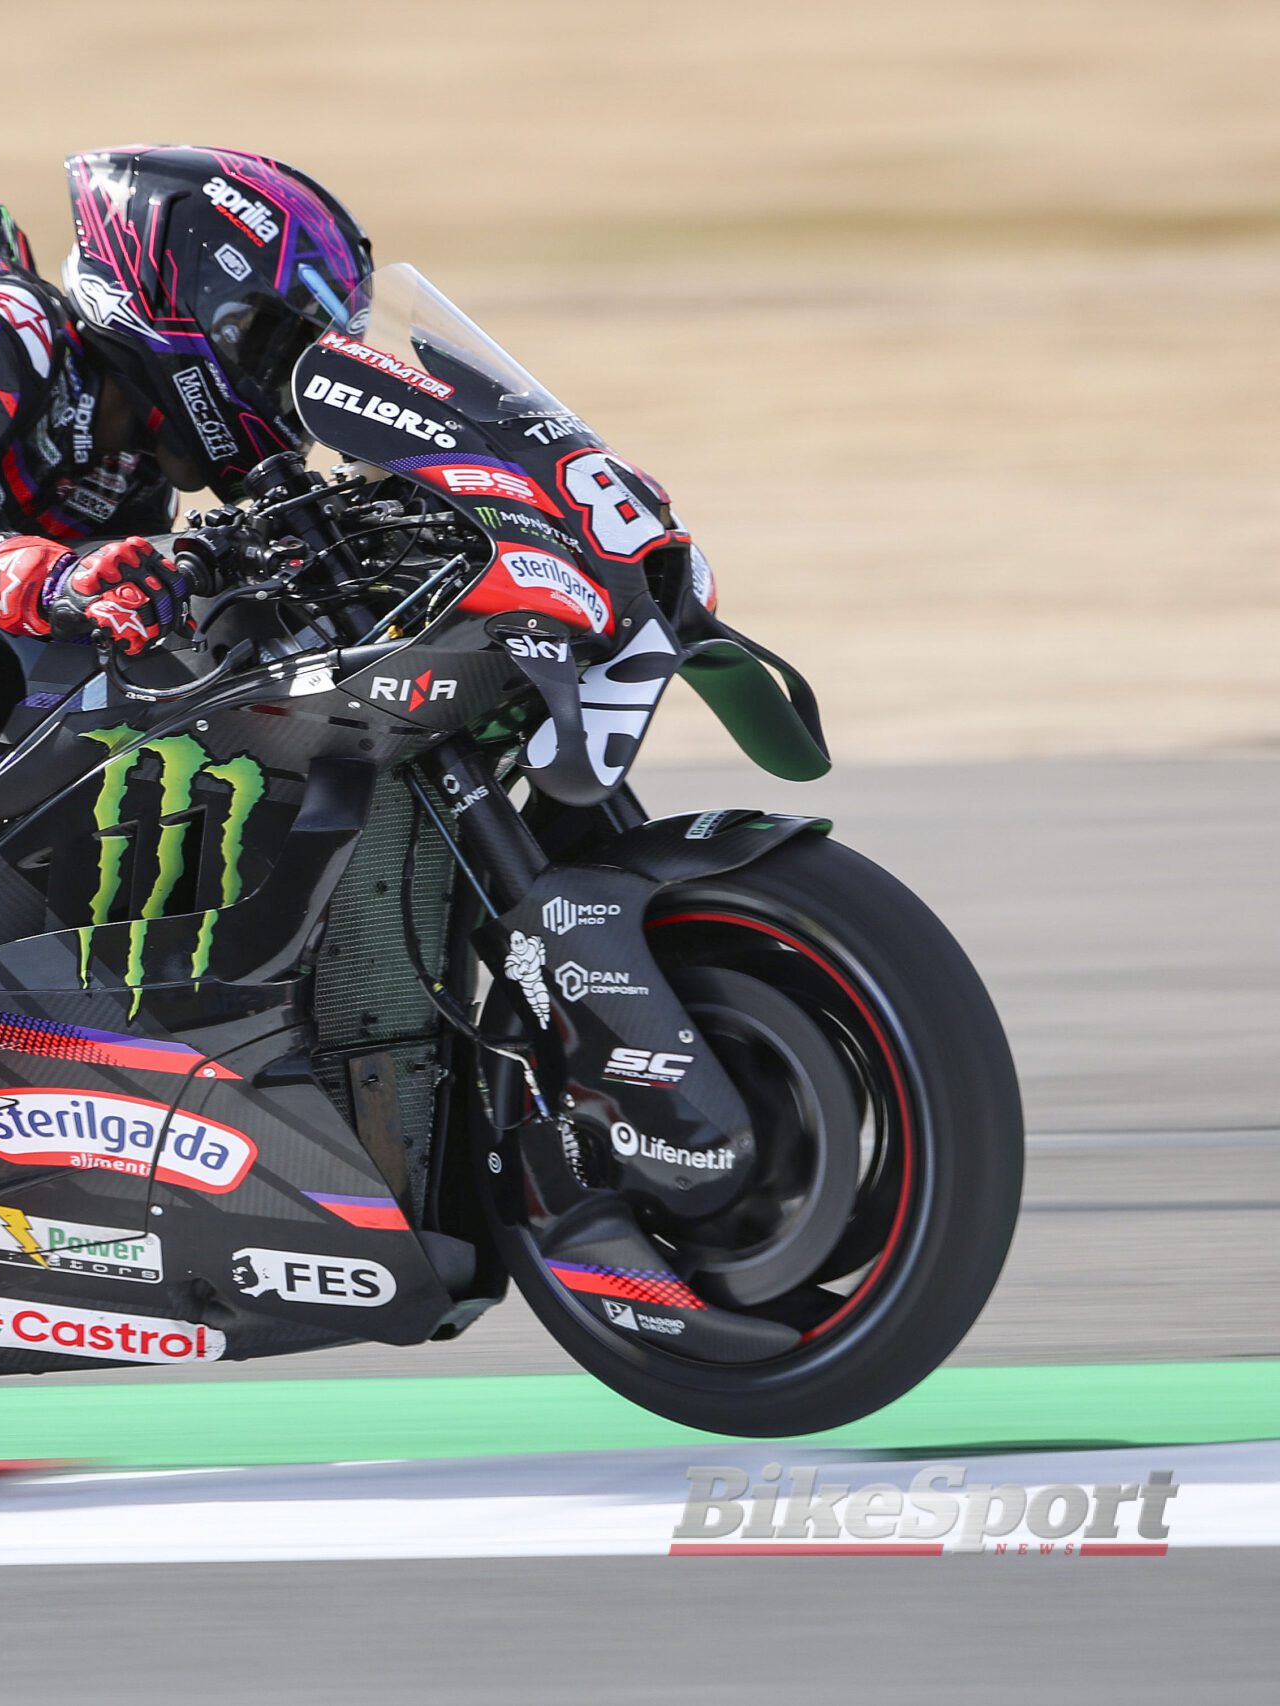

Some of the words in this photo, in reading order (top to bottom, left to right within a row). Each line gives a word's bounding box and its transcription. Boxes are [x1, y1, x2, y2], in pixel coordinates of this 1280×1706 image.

[202, 176, 280, 243] aprilia
[181, 370, 236, 456] Muc-Off
[302, 374, 457, 449] DELLORTO
[72, 392, 96, 464] aprilia
[441, 468, 534, 498] BS
[510, 556, 604, 623] sterilgarda
[505, 635, 568, 663] sky
[577, 904, 621, 916] MOD
[577, 917, 606, 926] MOD
[589, 971, 630, 984] PAN
[590, 985, 650, 996] COMPOSITI
[603, 1067, 683, 1083] PROJECT
[607, 1047, 695, 1077] SC
[69, 1153, 153, 1177] alimenti
[640, 1134, 736, 1170] Lifenet.it
[48, 1227, 145, 1261] Power
[283, 1262, 381, 1299] FES
[11, 1309, 207, 1359] Castrol
